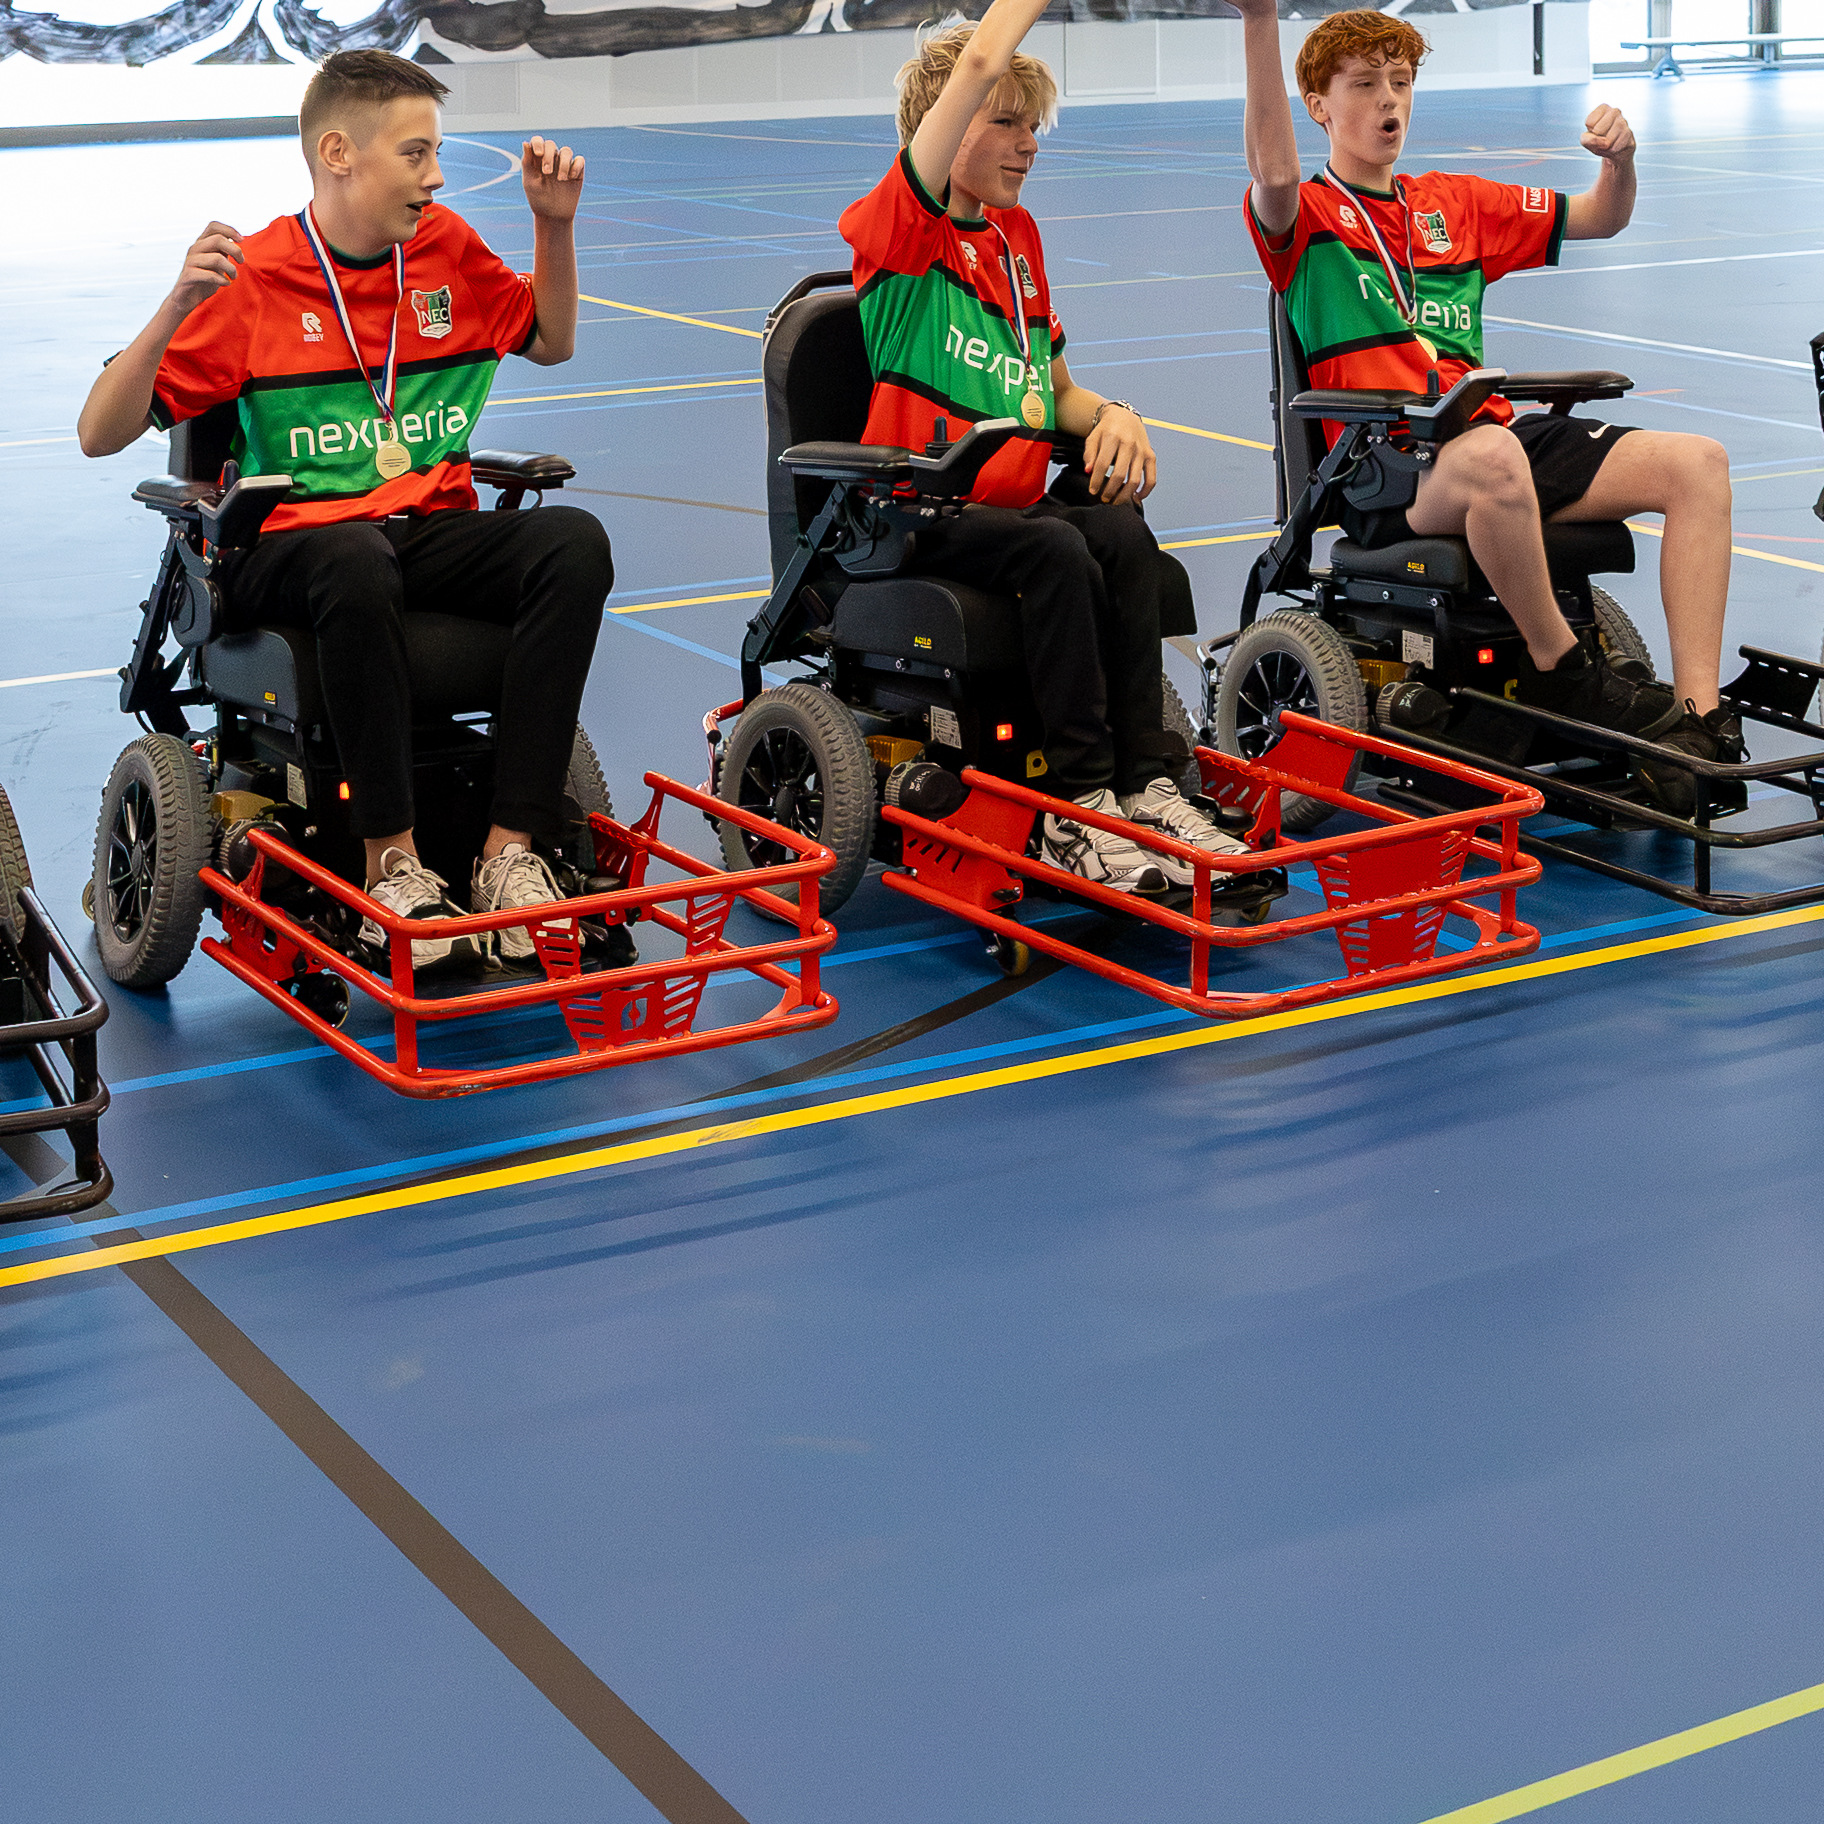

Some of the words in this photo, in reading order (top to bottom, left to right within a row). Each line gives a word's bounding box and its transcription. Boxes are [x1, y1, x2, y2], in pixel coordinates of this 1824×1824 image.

[1424, 227, 1447, 241] NEC
[421, 307, 449, 325] NEC
[289, 400, 469, 458] nexperia
